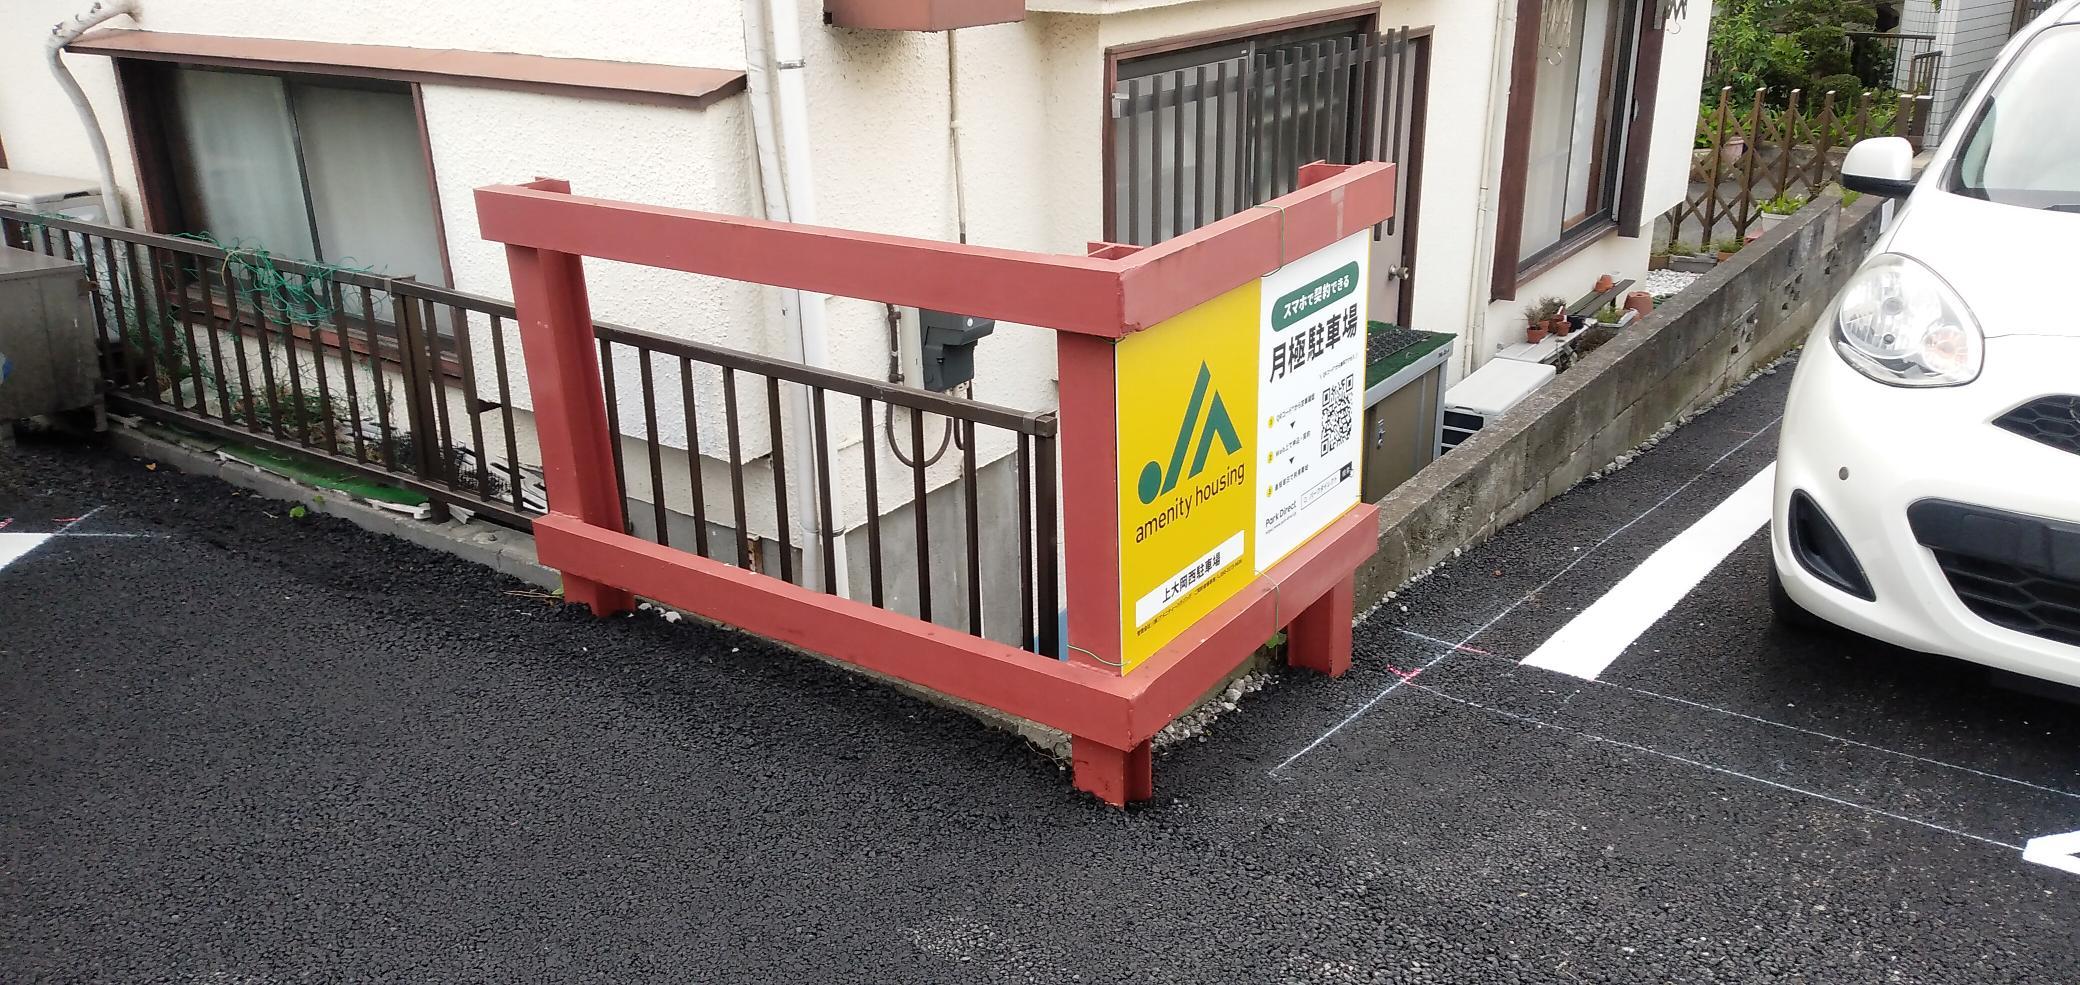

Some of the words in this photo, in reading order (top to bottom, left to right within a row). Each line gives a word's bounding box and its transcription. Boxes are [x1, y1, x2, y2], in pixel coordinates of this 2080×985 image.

[1283, 274, 1350, 319] スマホで契約できる
[1269, 302, 1358, 383] 月極駐車場
[1135, 494, 1193, 544] amenity
[1195, 463, 1245, 507] housing
[1265, 512, 1279, 528] Park
[1280, 500, 1297, 517] Direct
[1162, 551, 1221, 604] 上大岡西駐車場
